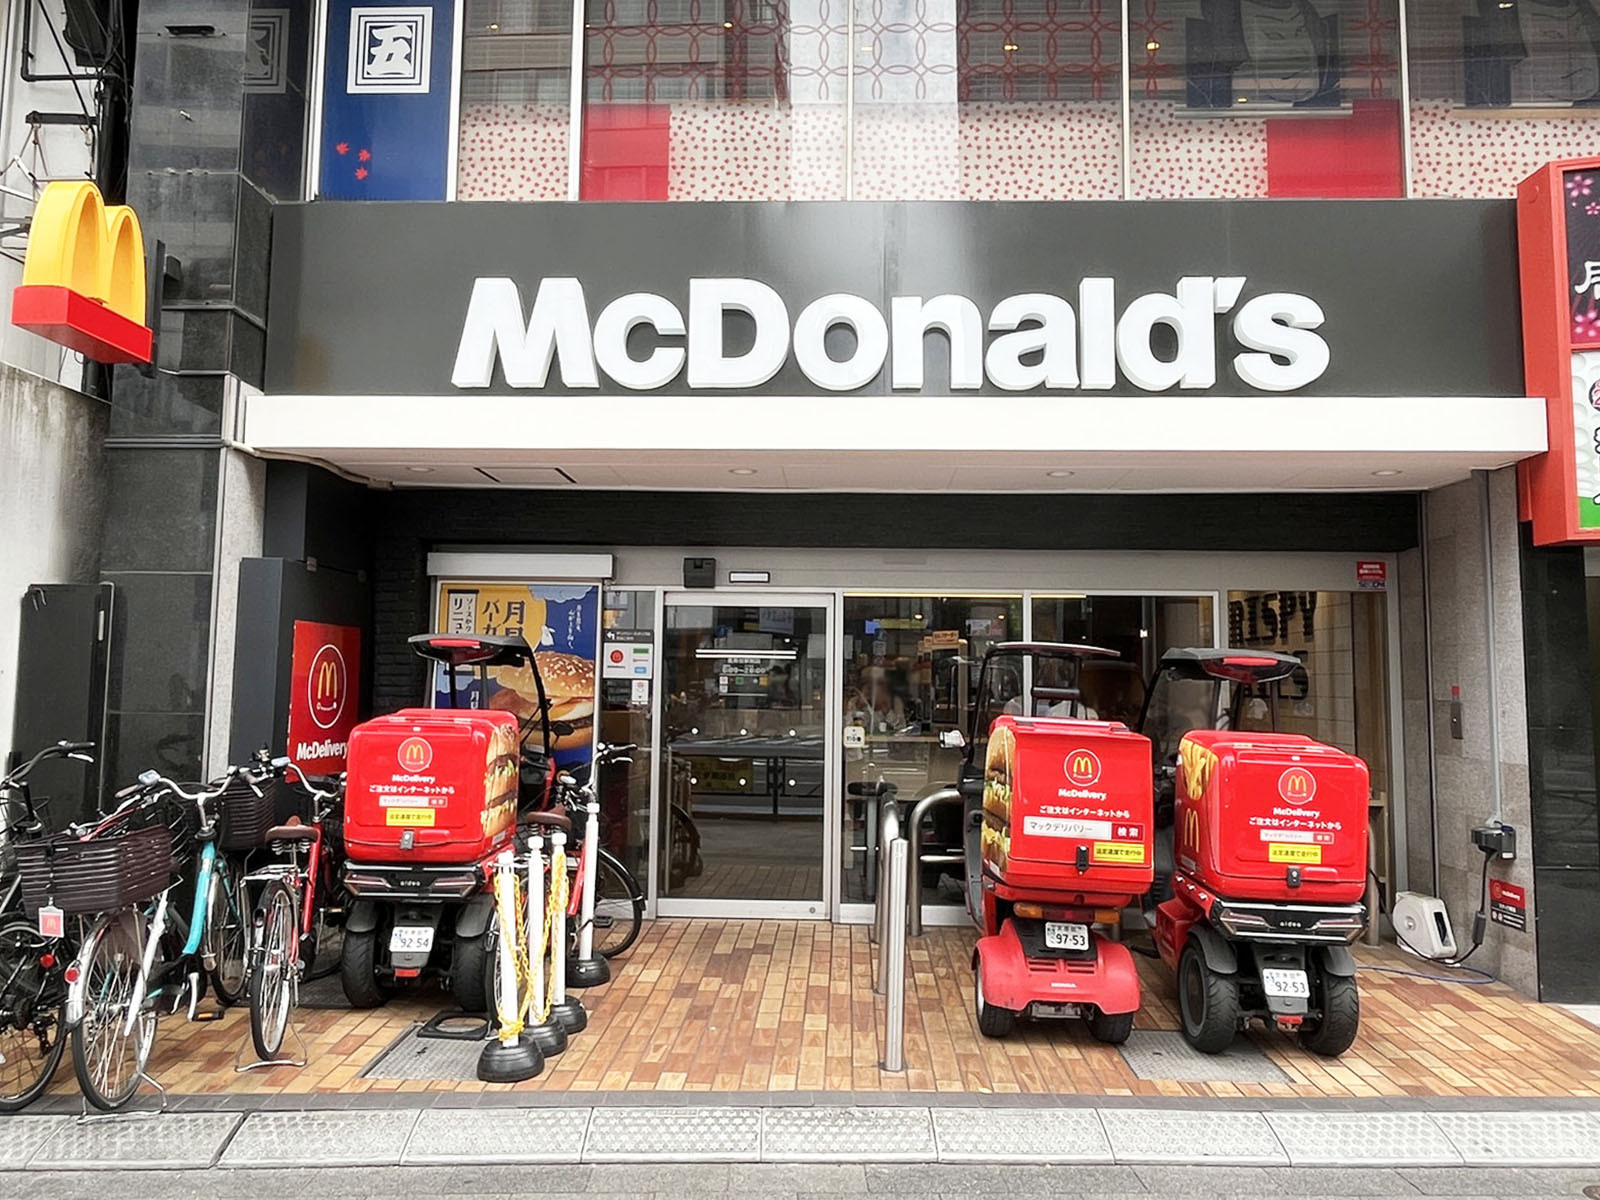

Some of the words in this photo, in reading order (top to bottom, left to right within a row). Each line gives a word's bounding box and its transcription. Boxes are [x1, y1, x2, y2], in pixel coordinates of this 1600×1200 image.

[451, 276, 1330, 392] McDonald's
[296, 739, 347, 761] McDelivery
[392, 774, 435, 784] McDelivery
[369, 784, 455, 795] ご注文はインターネットから
[1058, 788, 1107, 801] McDelivery
[1040, 805, 1130, 819] ご注文はインターネットから
[1273, 807, 1320, 819] McDelivery
[1030, 821, 1093, 833] マックデリバリー
[1249, 817, 1342, 830] ご注文はインターネットから
